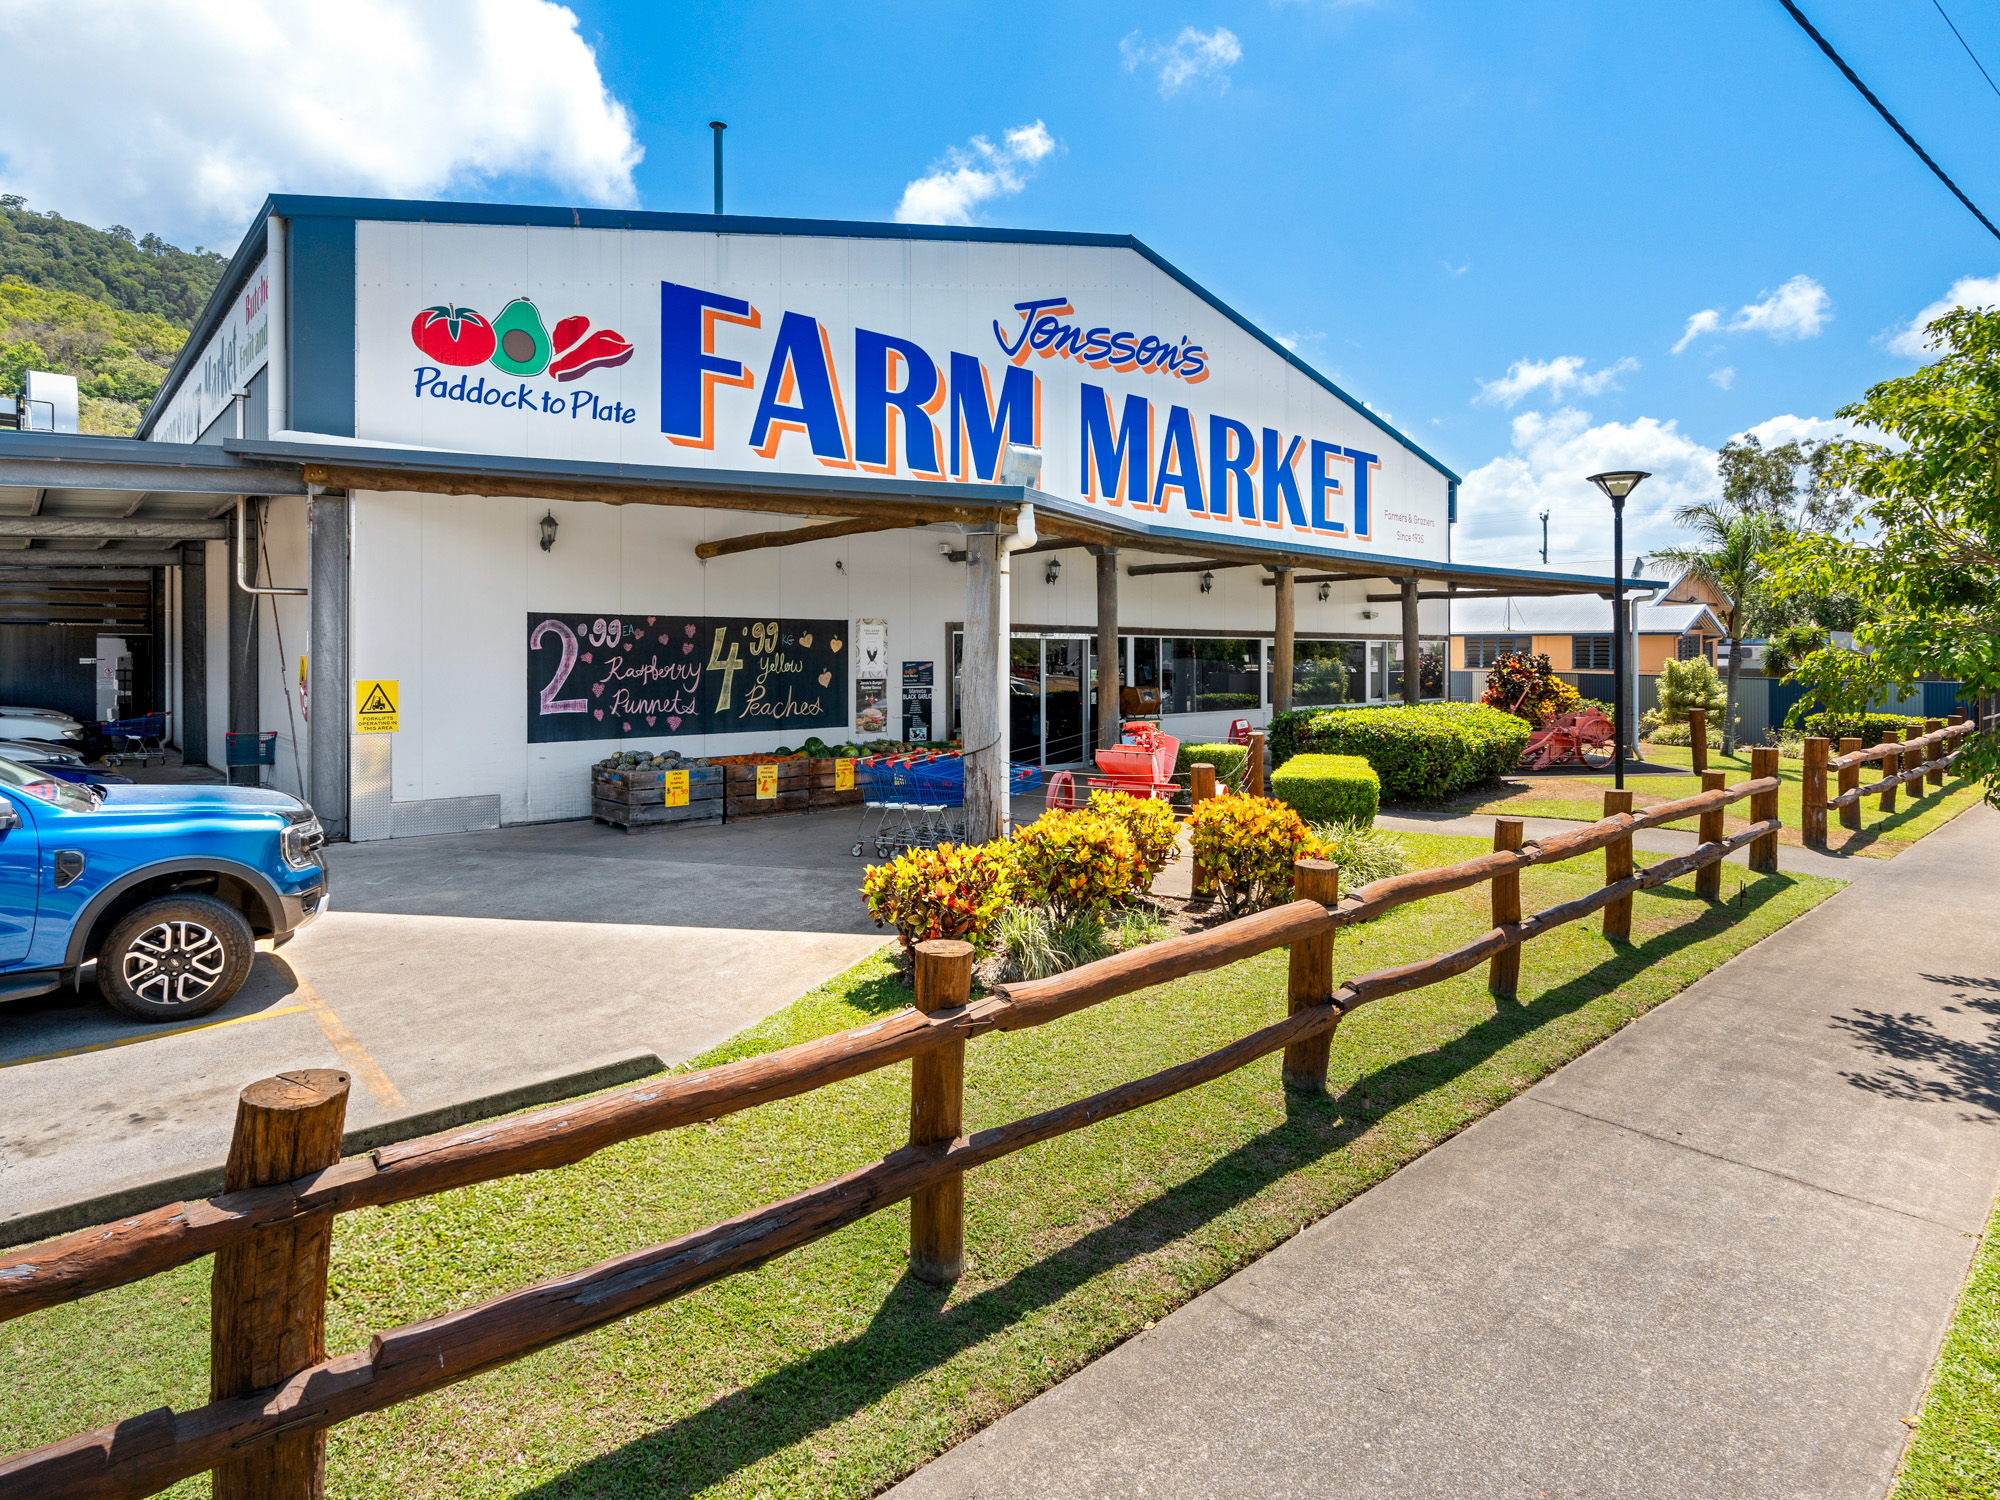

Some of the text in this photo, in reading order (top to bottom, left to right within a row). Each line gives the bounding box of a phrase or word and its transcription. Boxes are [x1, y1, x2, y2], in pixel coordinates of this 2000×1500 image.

[240, 313, 268, 374] Fruit and
[993, 297, 1209, 384] Jonsson's
[414, 366, 636, 424] Paddock to Plate
[661, 280, 1381, 542] FARM MARKET
[1384, 509, 1435, 528] Farmers & Graziers
[1396, 530, 1424, 544] Since 1935
[622, 624, 634, 637] EA
[782, 634, 795, 645] KG
[600, 655, 702, 693] Raspberry
[610, 688, 699, 716] Punnets
[739, 684, 824, 719] Peaches
